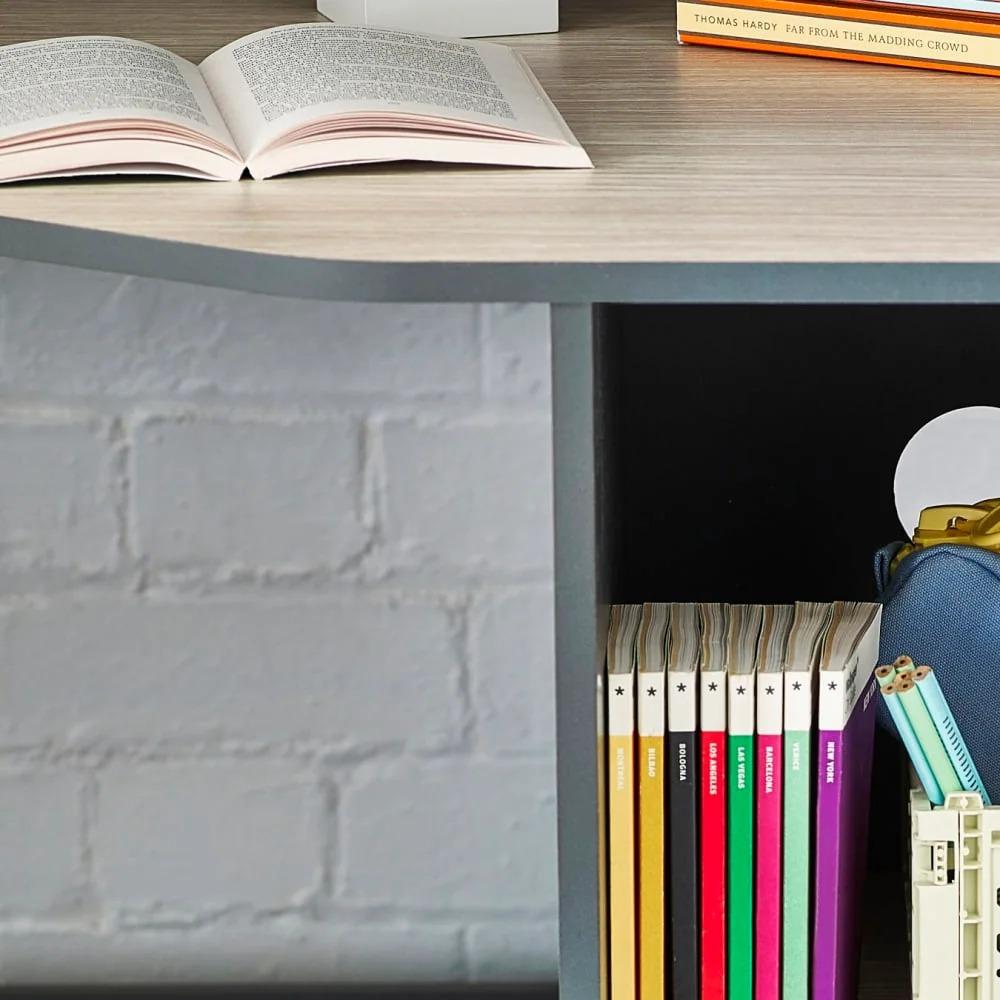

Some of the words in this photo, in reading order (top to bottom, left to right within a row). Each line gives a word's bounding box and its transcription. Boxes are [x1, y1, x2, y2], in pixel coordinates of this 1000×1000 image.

[694, 14, 738, 27] THOMAS
[742, 19, 777, 31] HARDY
[786, 24, 805, 35] FAR
[809, 27, 839, 39] FROM
[843, 31, 864, 42] THE
[868, 34, 923, 48] MADDING
[927, 40, 969, 53] CROWD
[648, 747, 656, 778] BILBAO
[679, 743, 687, 781] BOLOGNA
[709, 742, 718, 758] LOS
[737, 746, 746, 762] LAS
[827, 741, 835, 760] NEW
[709, 759, 718, 795] ANGELES
[737, 763, 746, 789] VEGAS
[765, 746, 774, 793] BARCELONA
[826, 761, 835, 783] YORK
